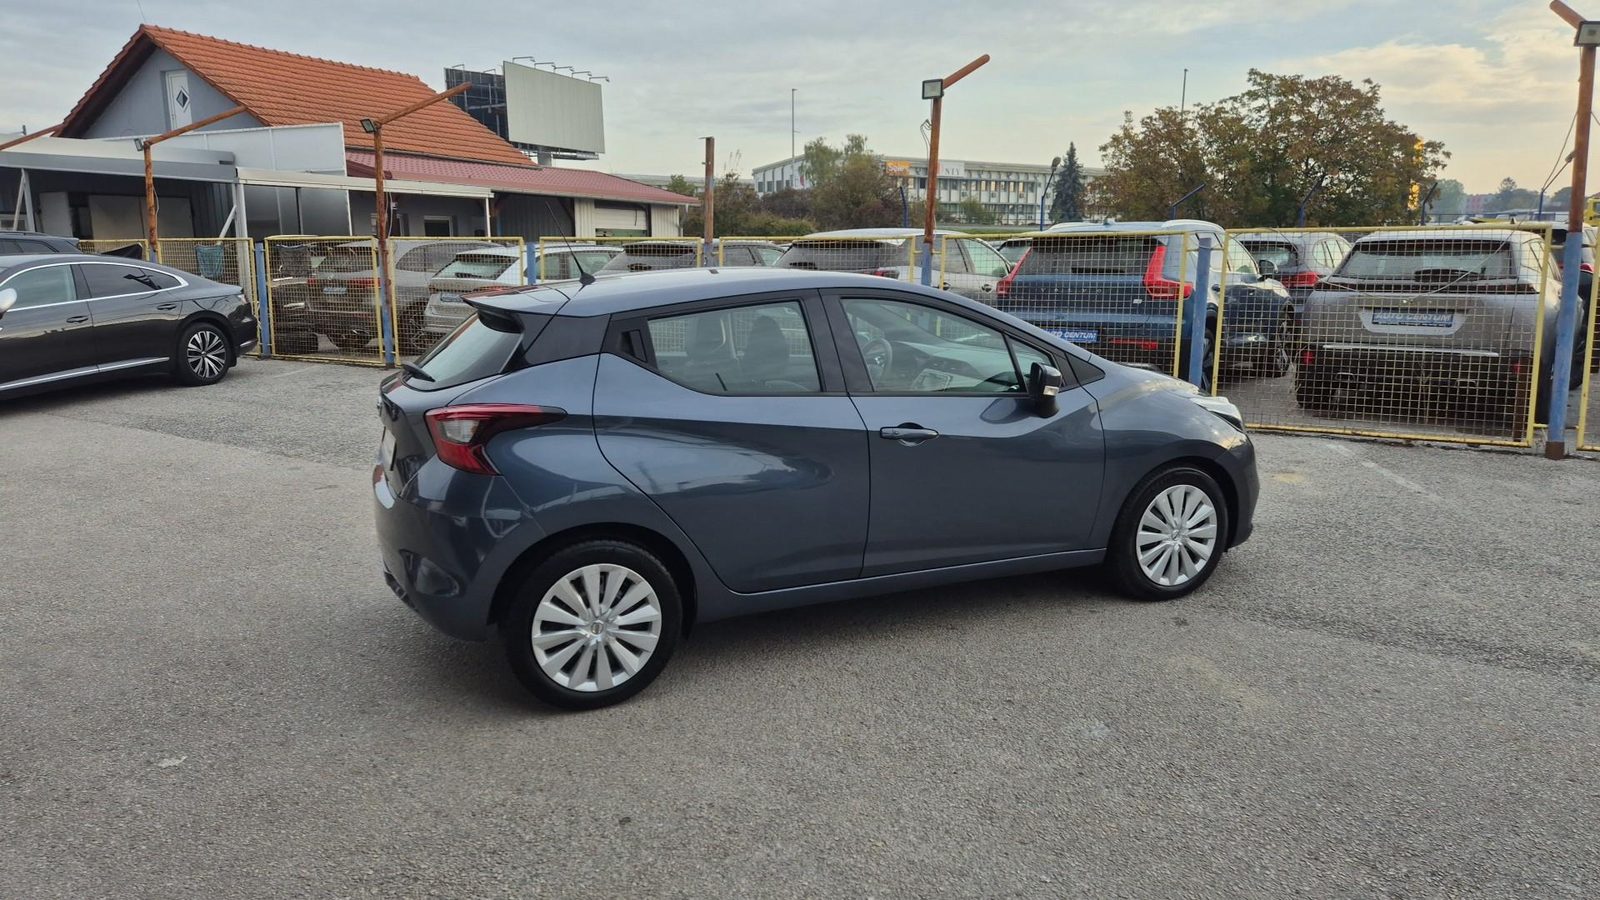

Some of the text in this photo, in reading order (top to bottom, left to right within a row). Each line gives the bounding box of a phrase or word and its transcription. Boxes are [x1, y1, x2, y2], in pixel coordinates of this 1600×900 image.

[1375, 312, 1450, 322] AUTO CENTUM
[1064, 331, 1096, 339] CENTUM
